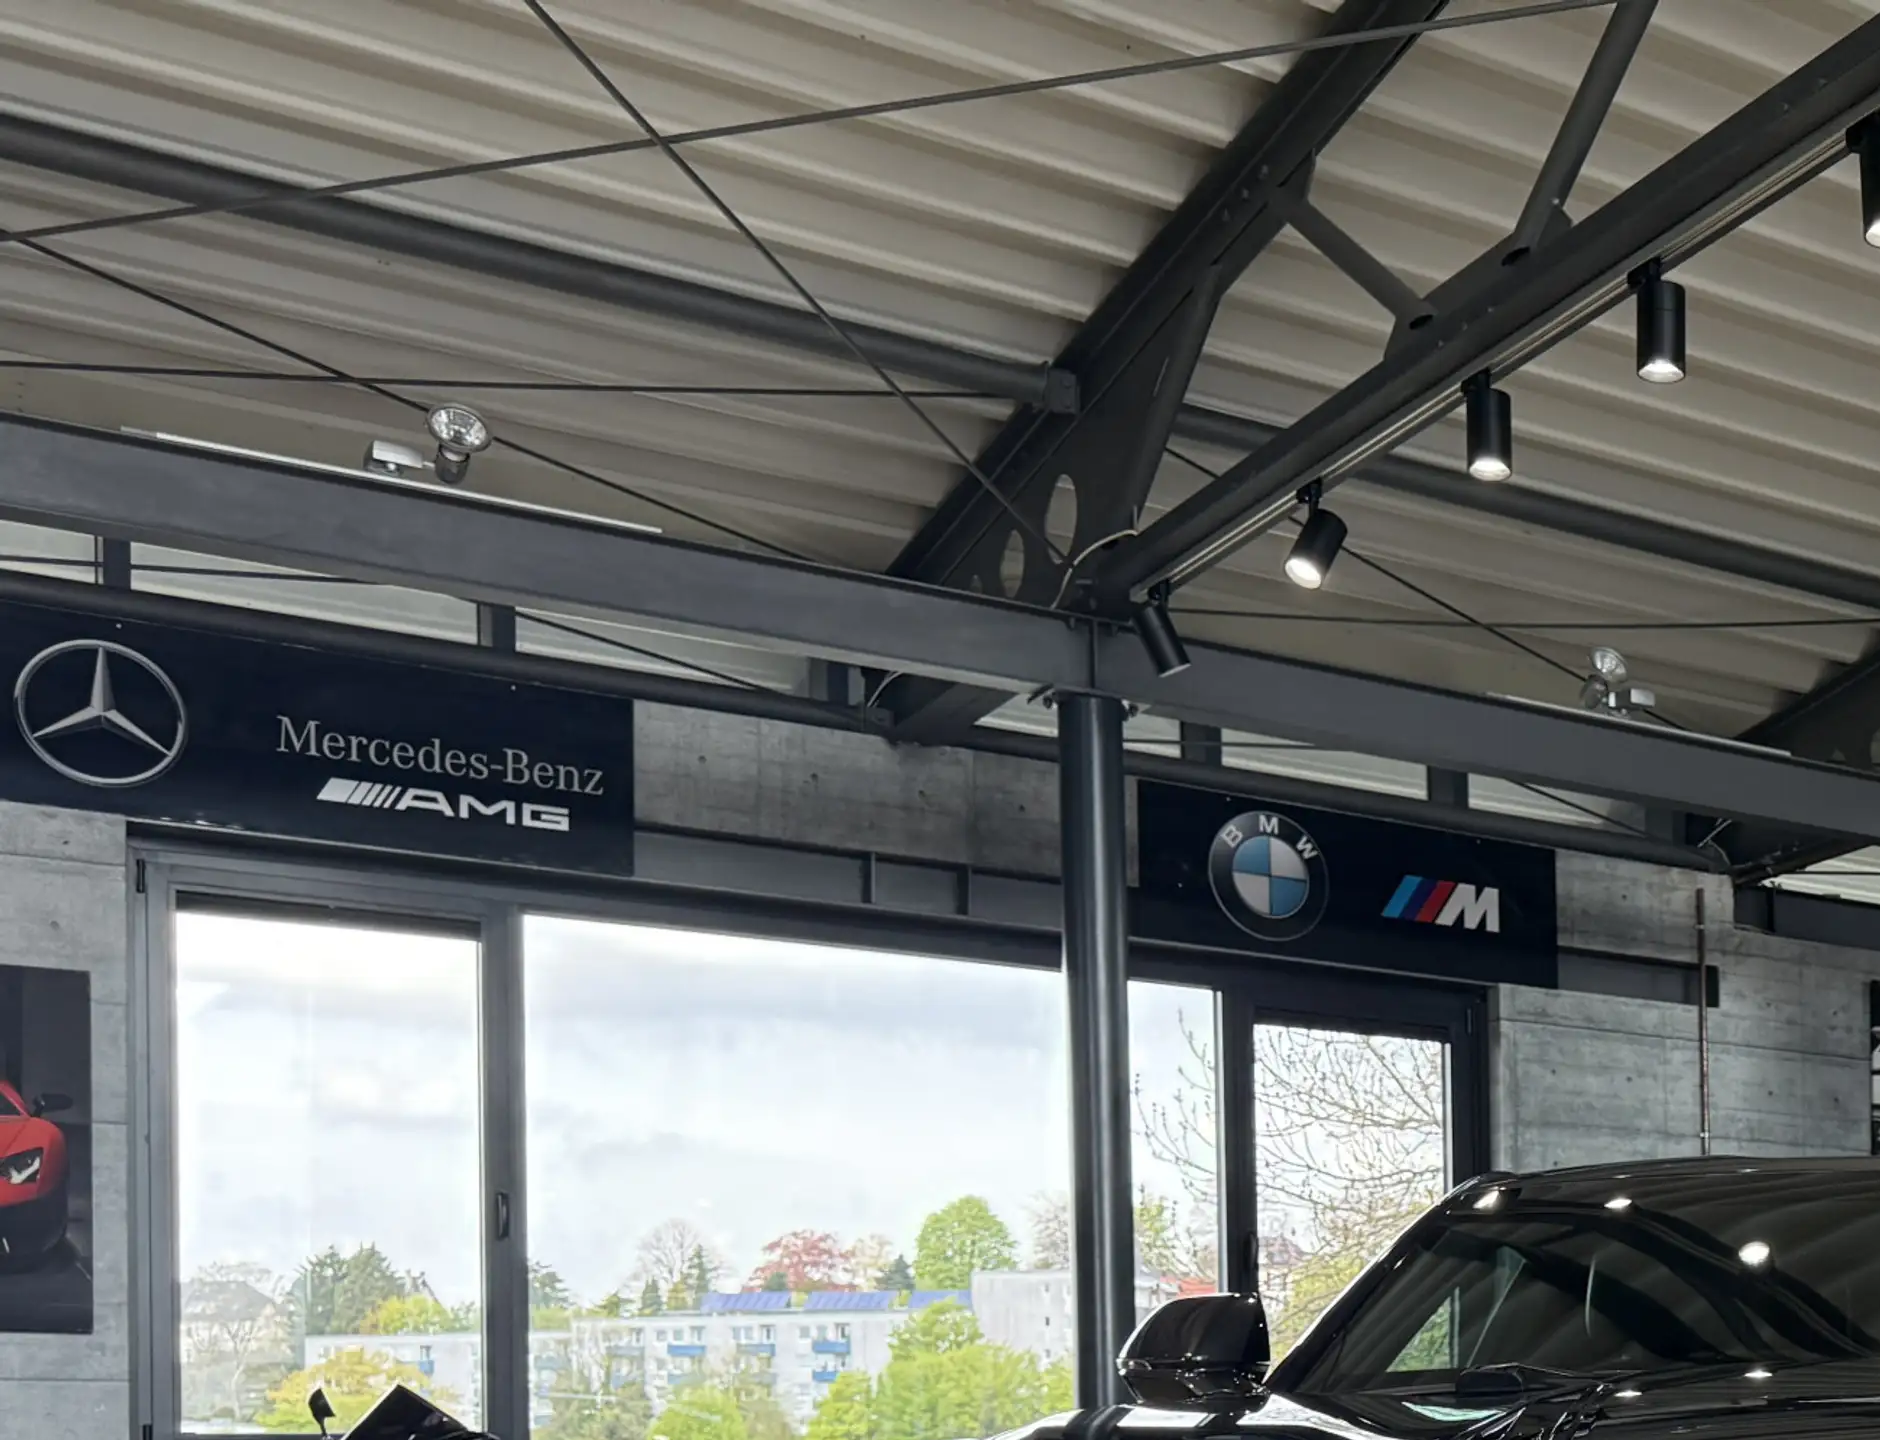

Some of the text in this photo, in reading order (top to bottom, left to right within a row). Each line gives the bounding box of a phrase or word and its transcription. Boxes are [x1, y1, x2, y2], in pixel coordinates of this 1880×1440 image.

[276, 715, 604, 796] Mercedes-Benz
[394, 788, 570, 832] AMG
[1220, 814, 1319, 860] BMW
[1435, 883, 1500, 933] M
